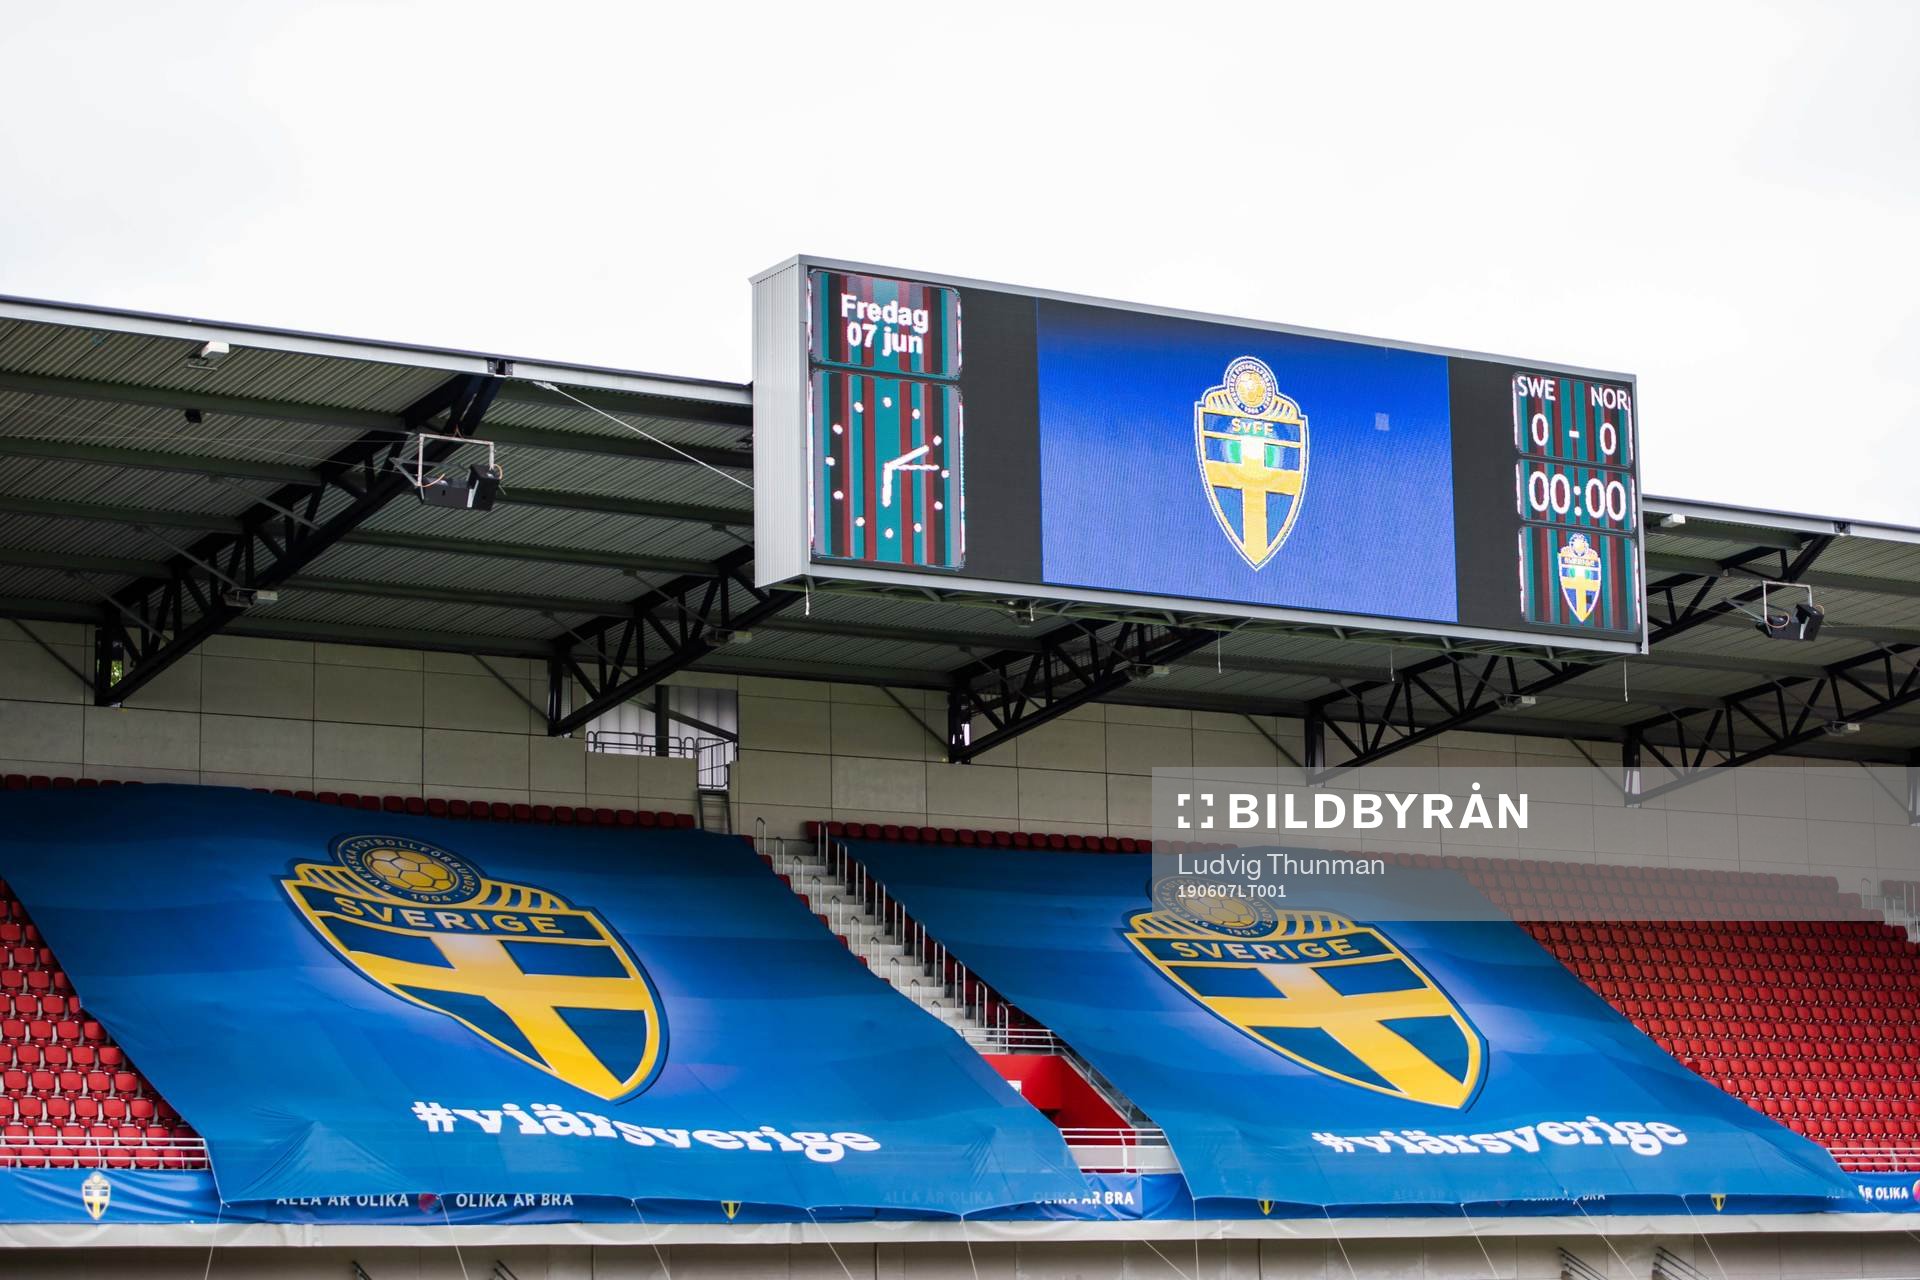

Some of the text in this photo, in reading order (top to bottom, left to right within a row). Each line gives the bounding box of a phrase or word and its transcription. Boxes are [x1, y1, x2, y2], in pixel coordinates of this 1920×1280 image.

[840, 293, 929, 335] Fredag
[847, 322, 923, 357] 07 jun
[1517, 376, 1556, 401] SWE
[1591, 386, 1629, 411] NOR
[1531, 413, 1549, 446] 0
[1599, 422, 1617, 455] 0
[1528, 470, 1627, 521] 00:00
[333, 896, 565, 934] SVERIGE
[1170, 938, 1361, 960] SVERIGE
[411, 1101, 882, 1163] #viärsverige
[1311, 1115, 1688, 1156] #viärsverige
[356, 1192, 409, 1207] OLIKA
[455, 1193, 508, 1208] OLIKA
[541, 1192, 574, 1207] BRA
[1104, 1191, 1135, 1205] BRA
[1875, 1186, 1910, 1200] OLIKA
